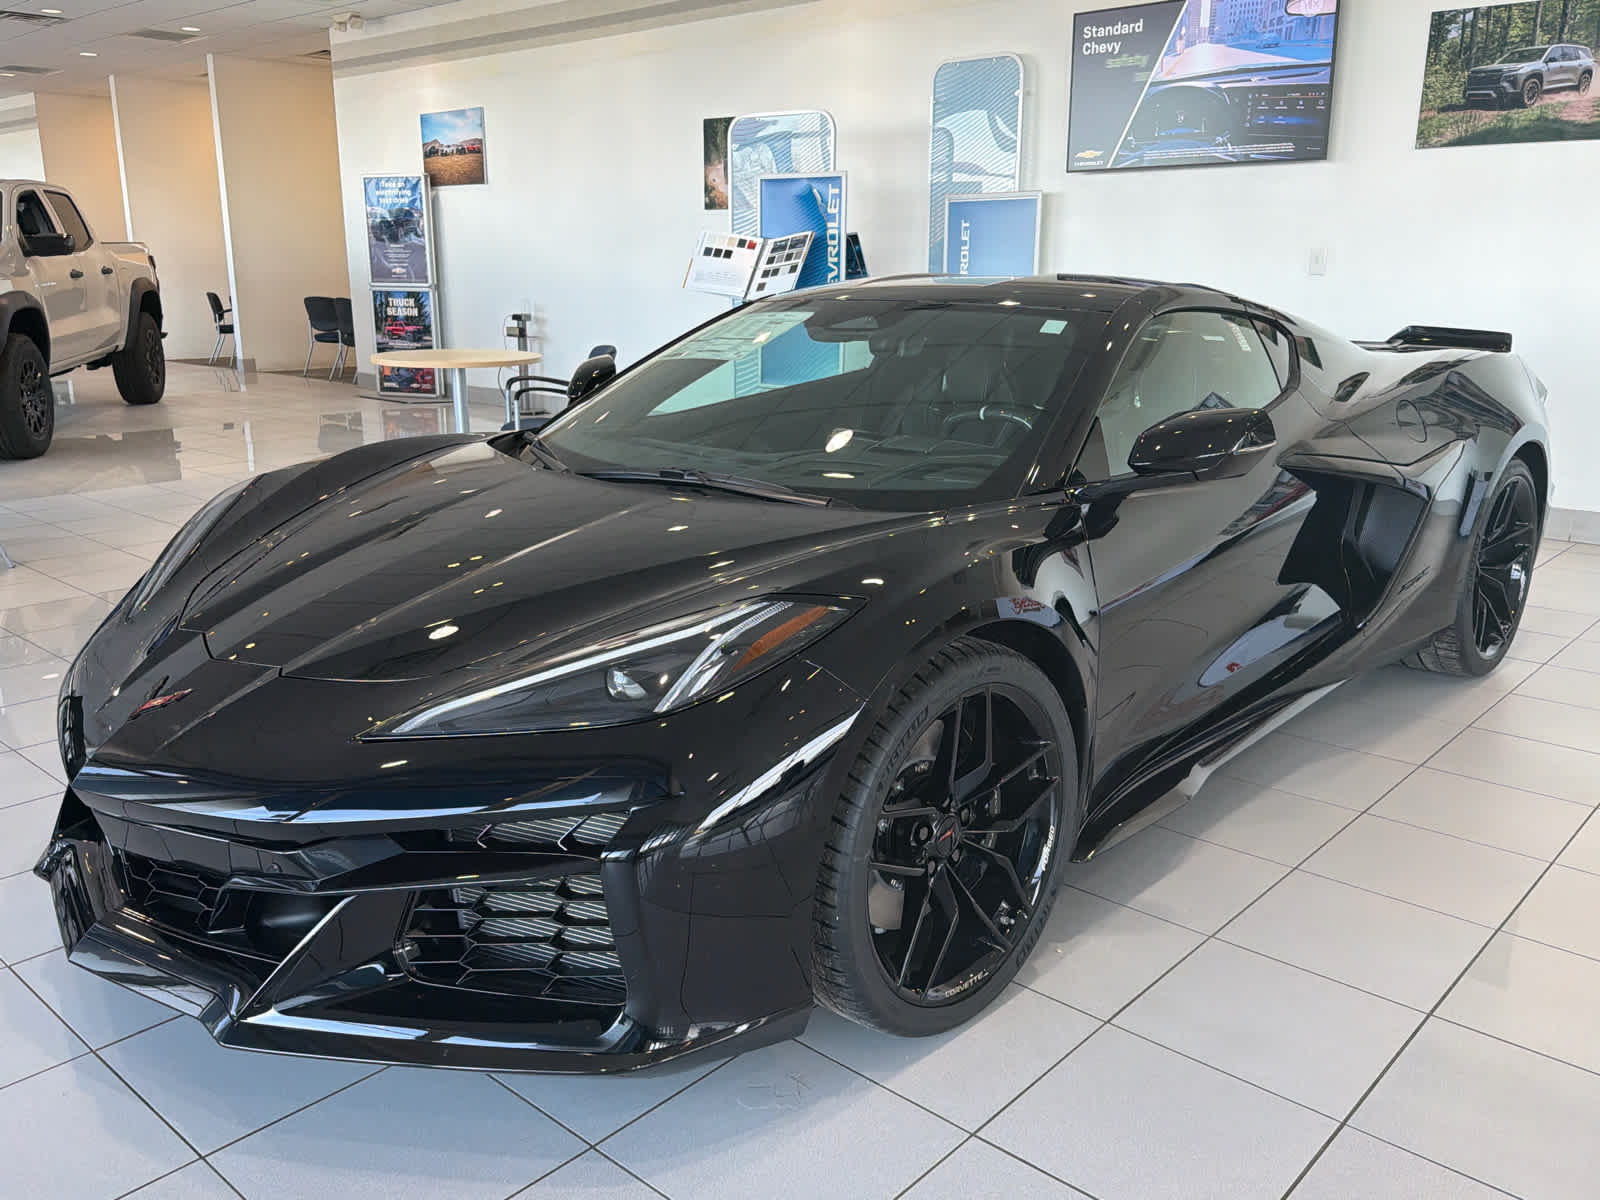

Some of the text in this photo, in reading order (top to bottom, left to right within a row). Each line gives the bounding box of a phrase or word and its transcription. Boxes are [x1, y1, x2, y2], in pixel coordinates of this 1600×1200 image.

[1083, 19, 1144, 39] Standard
[1082, 41, 1121, 55] Chevy
[827, 183, 840, 283] VROLET
[959, 219, 970, 275] ROLET
[388, 297, 415, 307] TRUCK
[386, 306, 418, 317] SEASON
